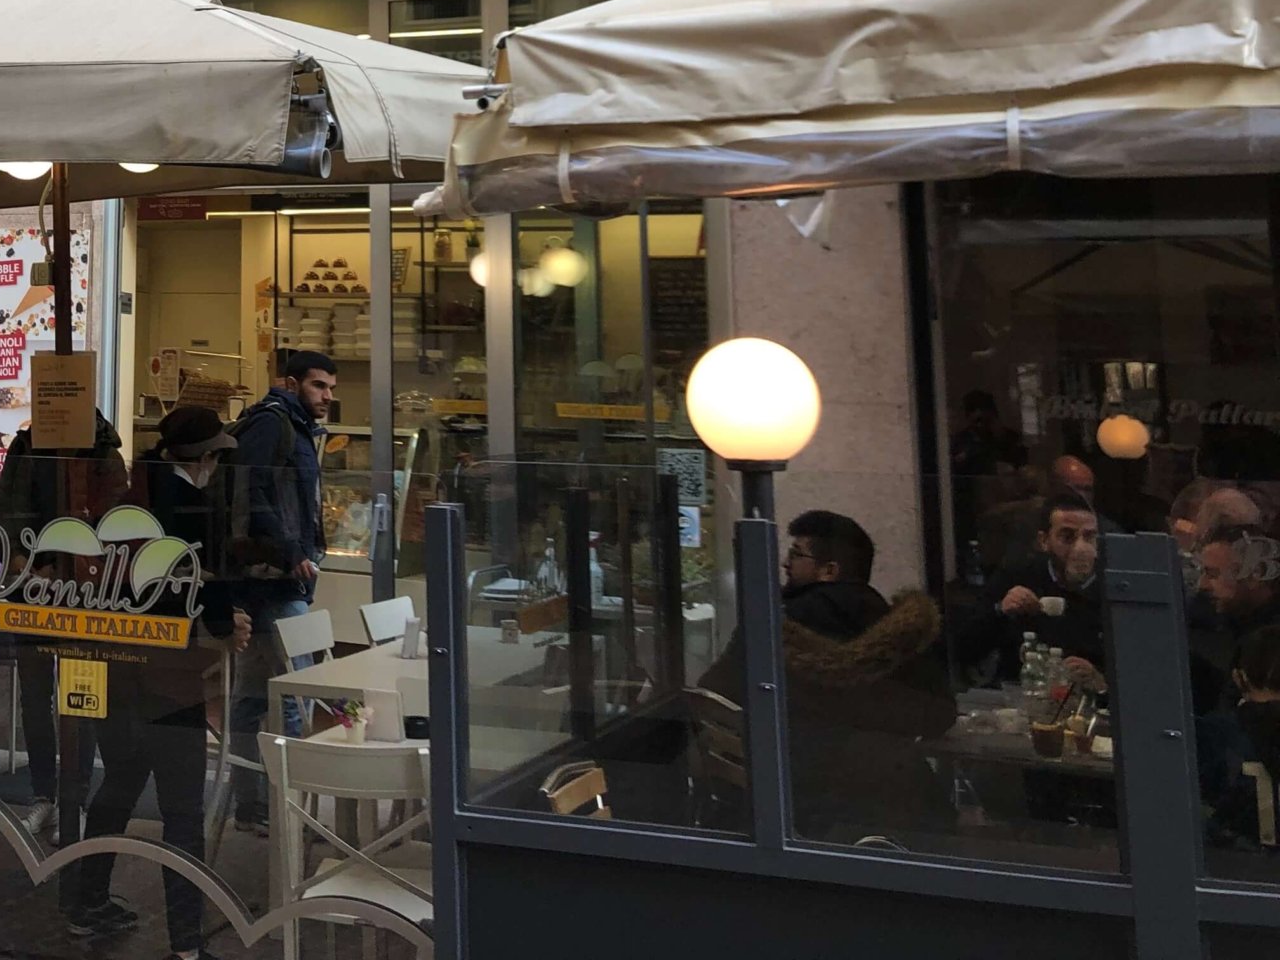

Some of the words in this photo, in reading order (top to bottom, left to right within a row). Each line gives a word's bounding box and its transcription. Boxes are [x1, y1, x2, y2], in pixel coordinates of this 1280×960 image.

[4, 607, 79, 633] GELATI
[84, 615, 181, 642] ITALIANI
[74, 683, 93, 693] FREE
